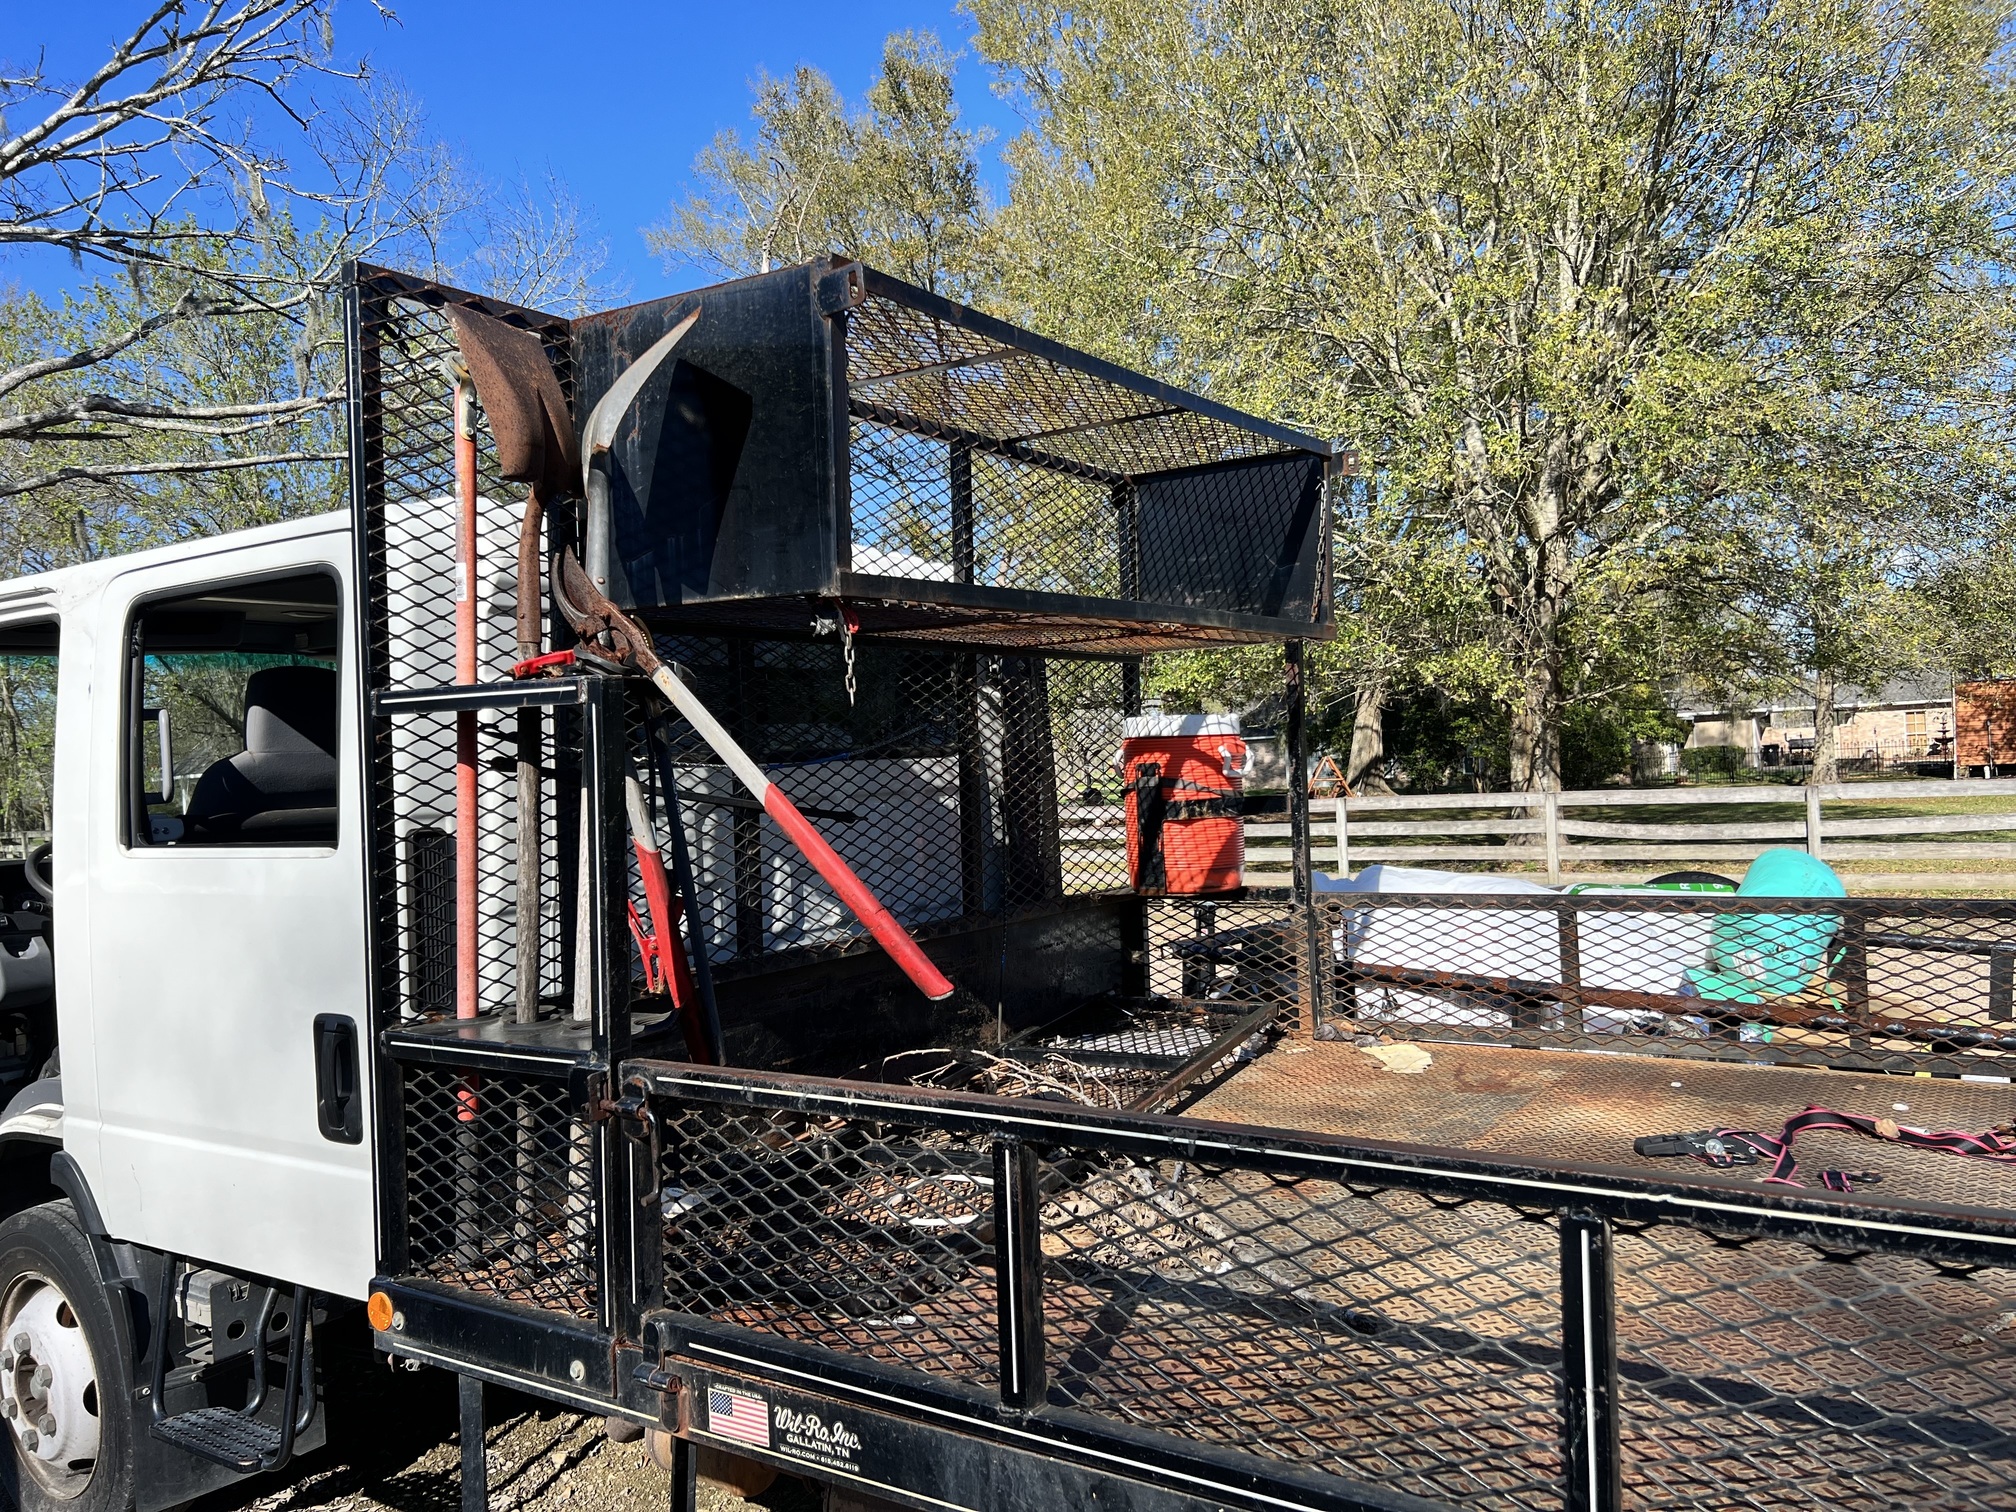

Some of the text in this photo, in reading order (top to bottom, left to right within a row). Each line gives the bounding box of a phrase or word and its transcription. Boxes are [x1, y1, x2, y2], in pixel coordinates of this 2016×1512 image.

[786, 1433, 850, 1459] GALLATIN, TN
[830, 1420, 862, 1451] Inc.
